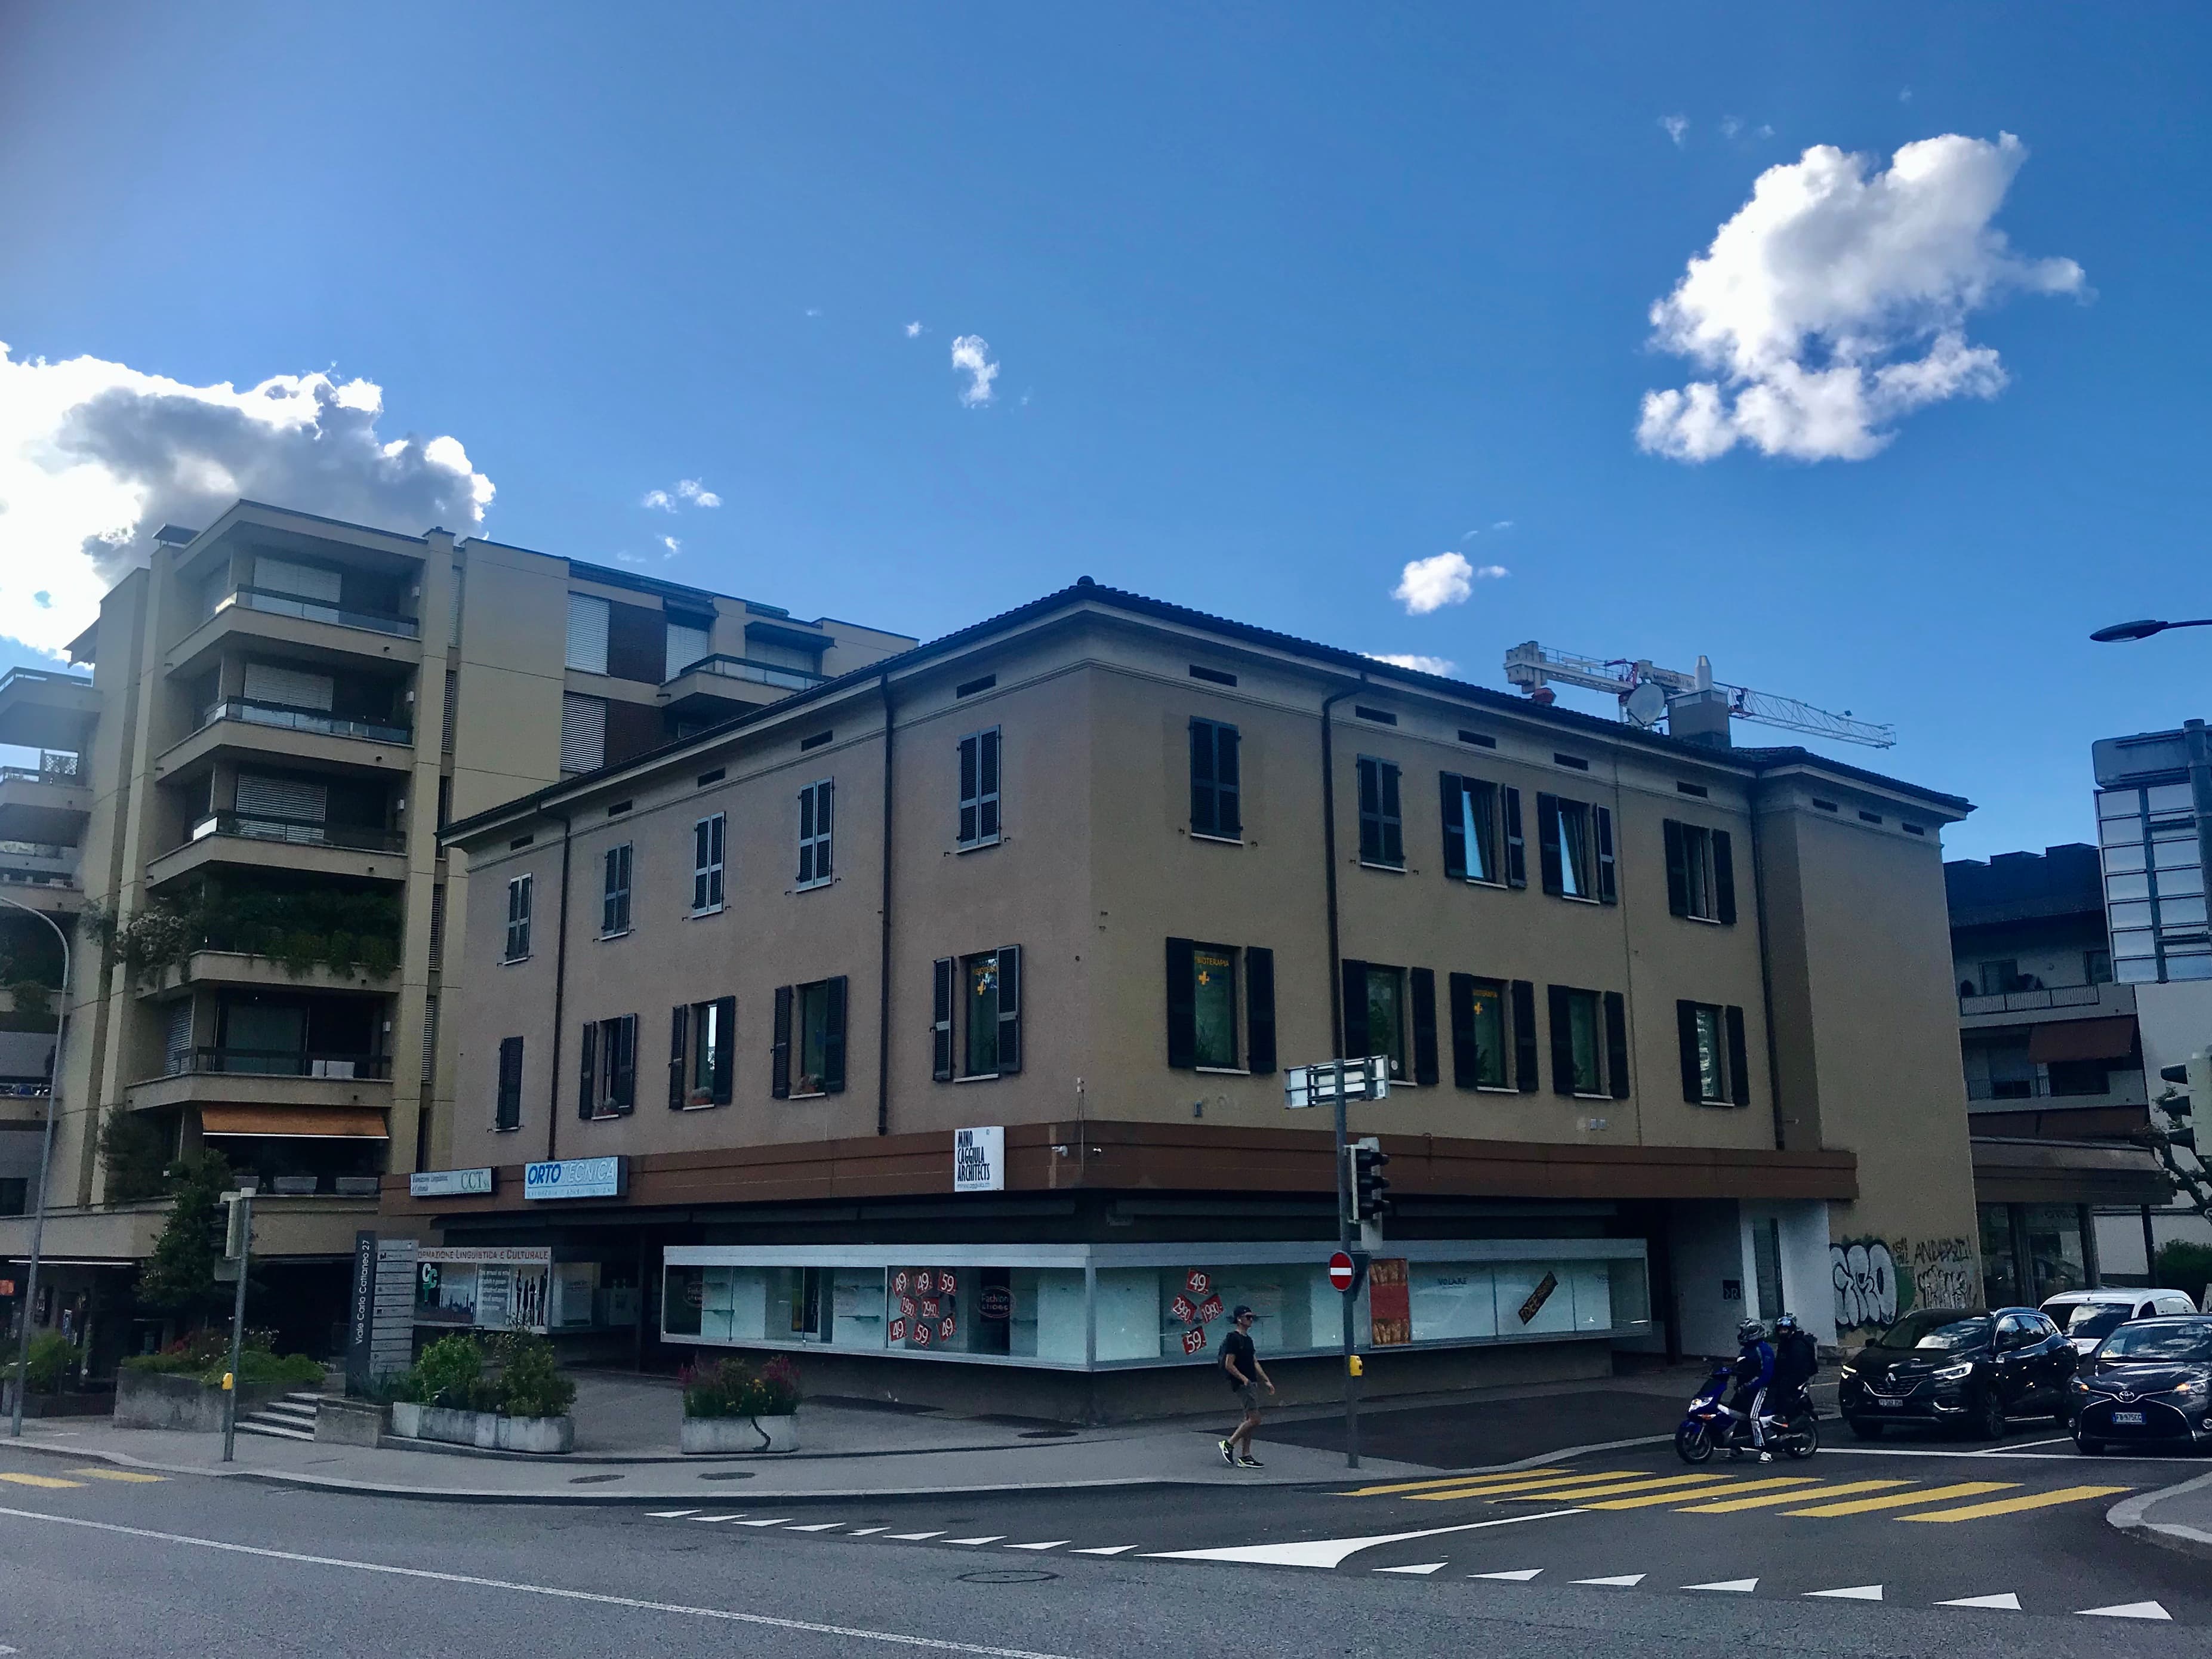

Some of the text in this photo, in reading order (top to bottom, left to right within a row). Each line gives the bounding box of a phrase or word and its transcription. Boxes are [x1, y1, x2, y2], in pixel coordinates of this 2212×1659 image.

[957, 1130, 973, 1148] MINO
[957, 1146, 985, 1164] CAGGIULA
[461, 1171, 483, 1189] CCT
[957, 1162, 990, 1182] ARCHITECTS
[418, 1251, 454, 1259] ORMAZIONE
[507, 1250, 549, 1260] CULTURALE
[356, 1240, 370, 1344] Viale Carlo Cattaneo 27
